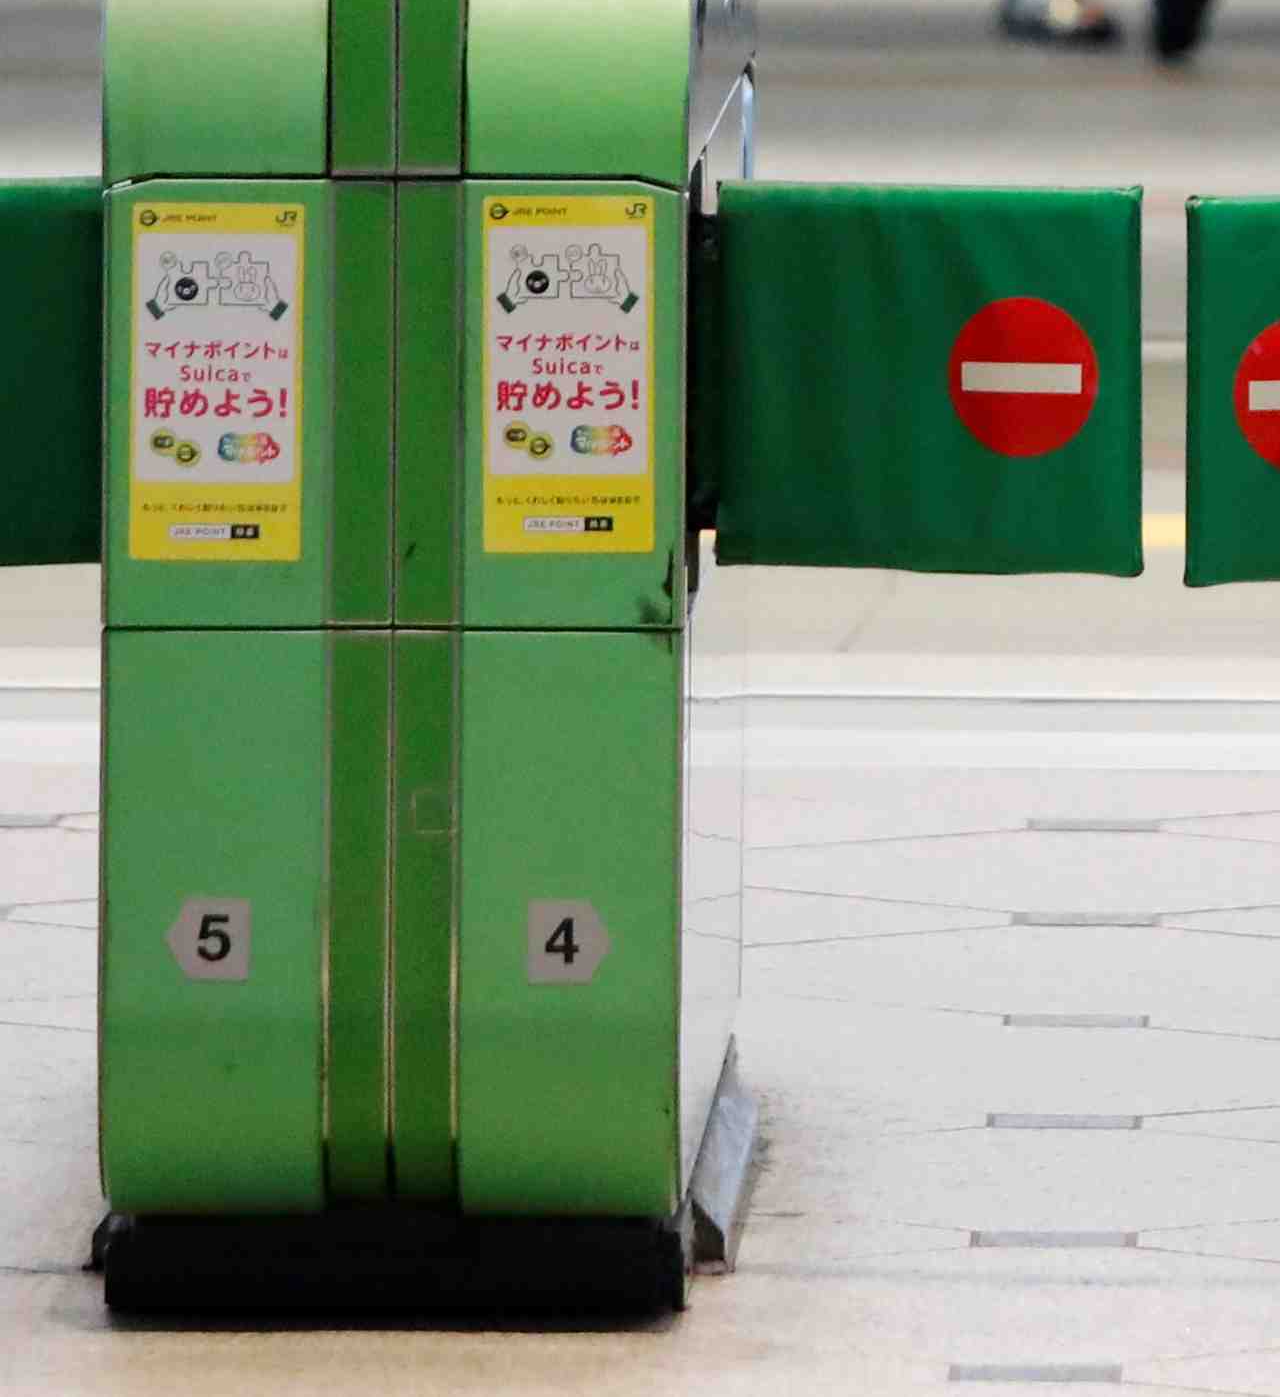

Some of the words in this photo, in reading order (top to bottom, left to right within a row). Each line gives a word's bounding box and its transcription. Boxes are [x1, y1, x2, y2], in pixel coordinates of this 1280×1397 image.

[145, 340, 289, 360] マイナポイントは
[497, 333, 640, 352] マイナポイントは
[144, 387, 288, 419] 貯めよう!
[497, 380, 640, 411] 貯めよう!
[196, 914, 231, 962] 5
[544, 917, 580, 964] 4
